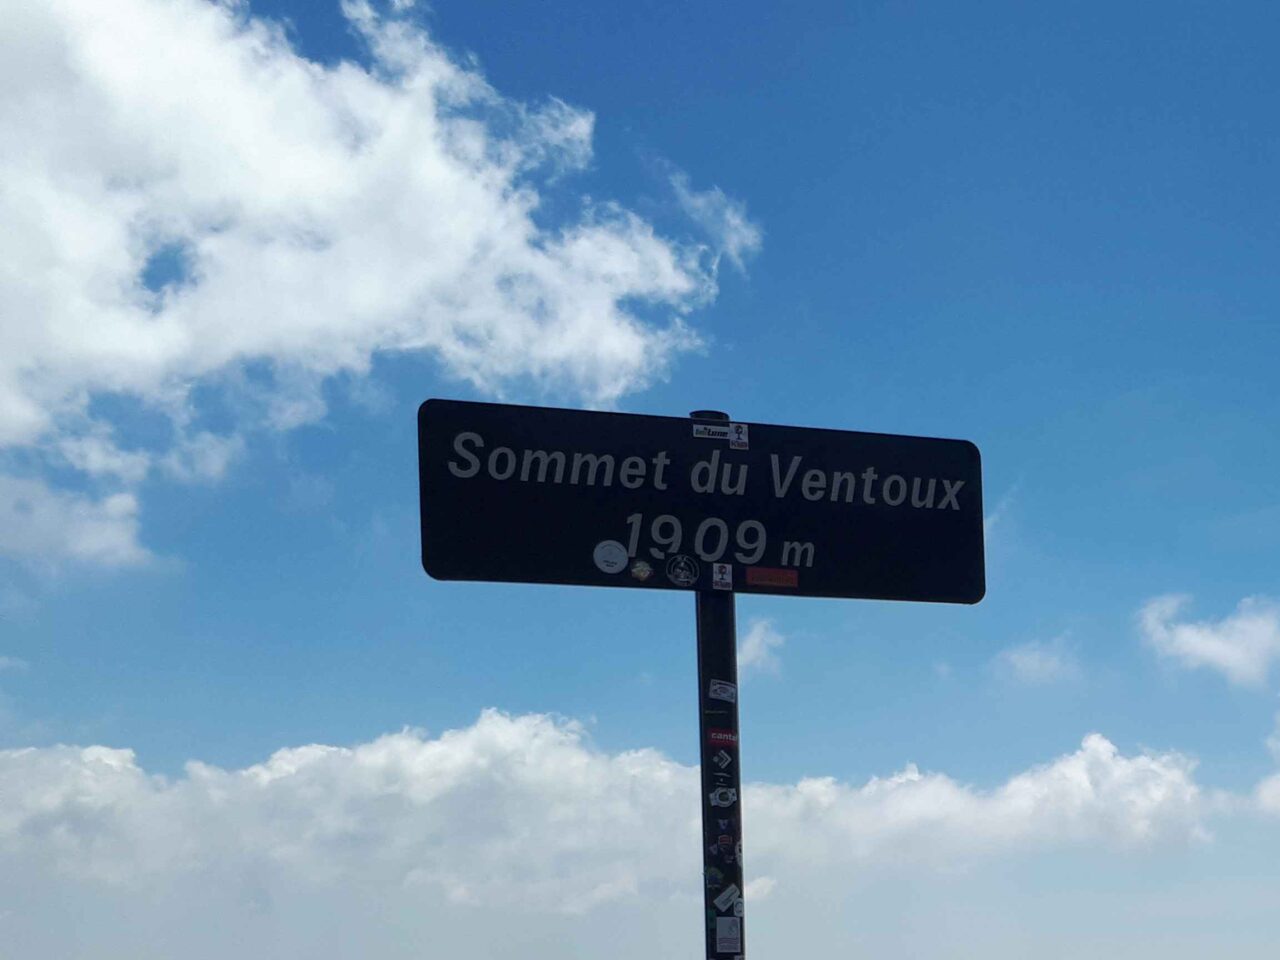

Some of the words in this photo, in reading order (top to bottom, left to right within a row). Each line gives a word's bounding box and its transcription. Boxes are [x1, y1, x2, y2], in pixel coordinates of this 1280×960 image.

[447, 431, 670, 492] Sommet
[690, 449, 749, 496] du
[770, 454, 965, 511] Ventoux
[625, 513, 767, 565] 1909
[781, 540, 815, 567] m
